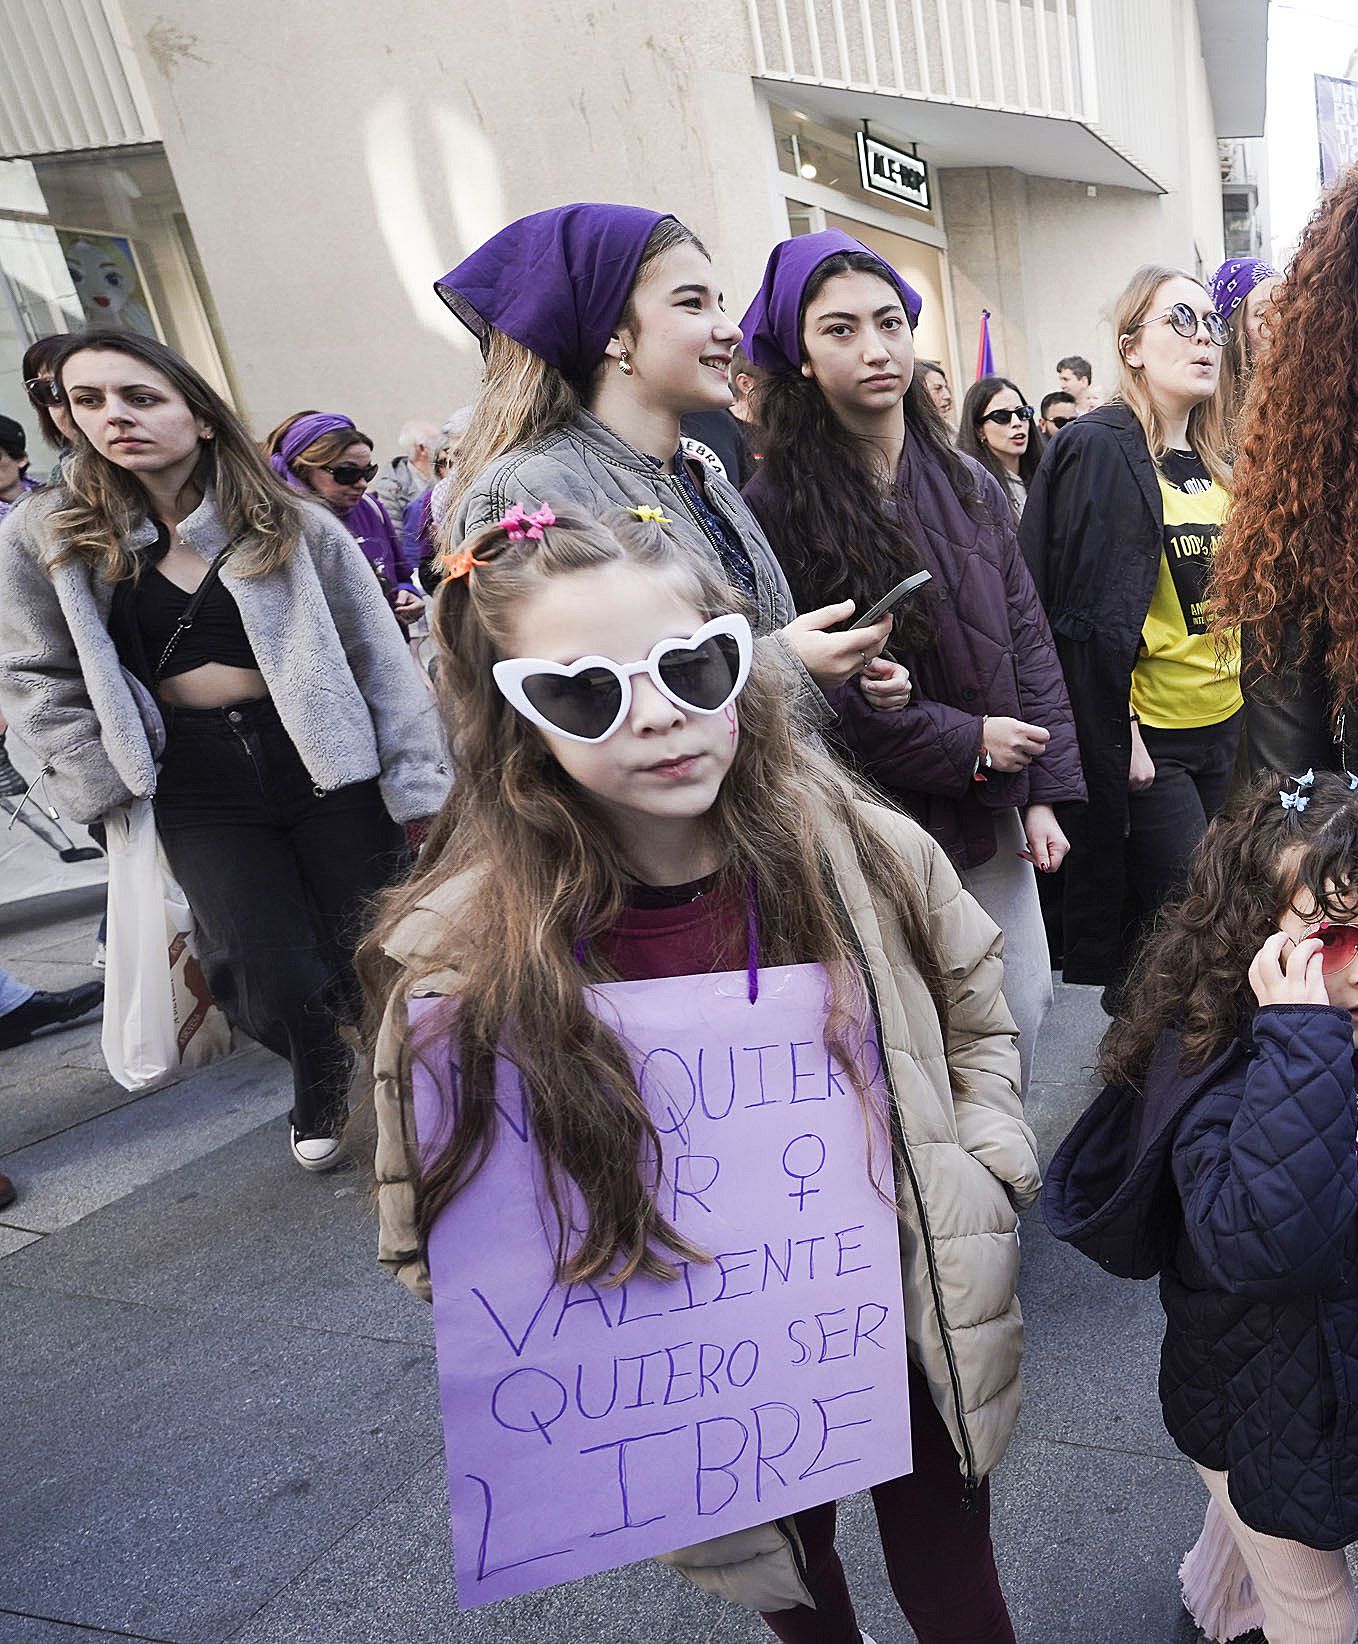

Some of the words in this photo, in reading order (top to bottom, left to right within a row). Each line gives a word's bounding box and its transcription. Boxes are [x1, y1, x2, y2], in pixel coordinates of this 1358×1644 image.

[1170, 535, 1209, 559] 100%
[471, 1225, 872, 1357] VALIENTE
[491, 1339, 760, 1446] QUIERO
[788, 1302, 889, 1367] SER
[465, 1386, 875, 1582] LIBRE
